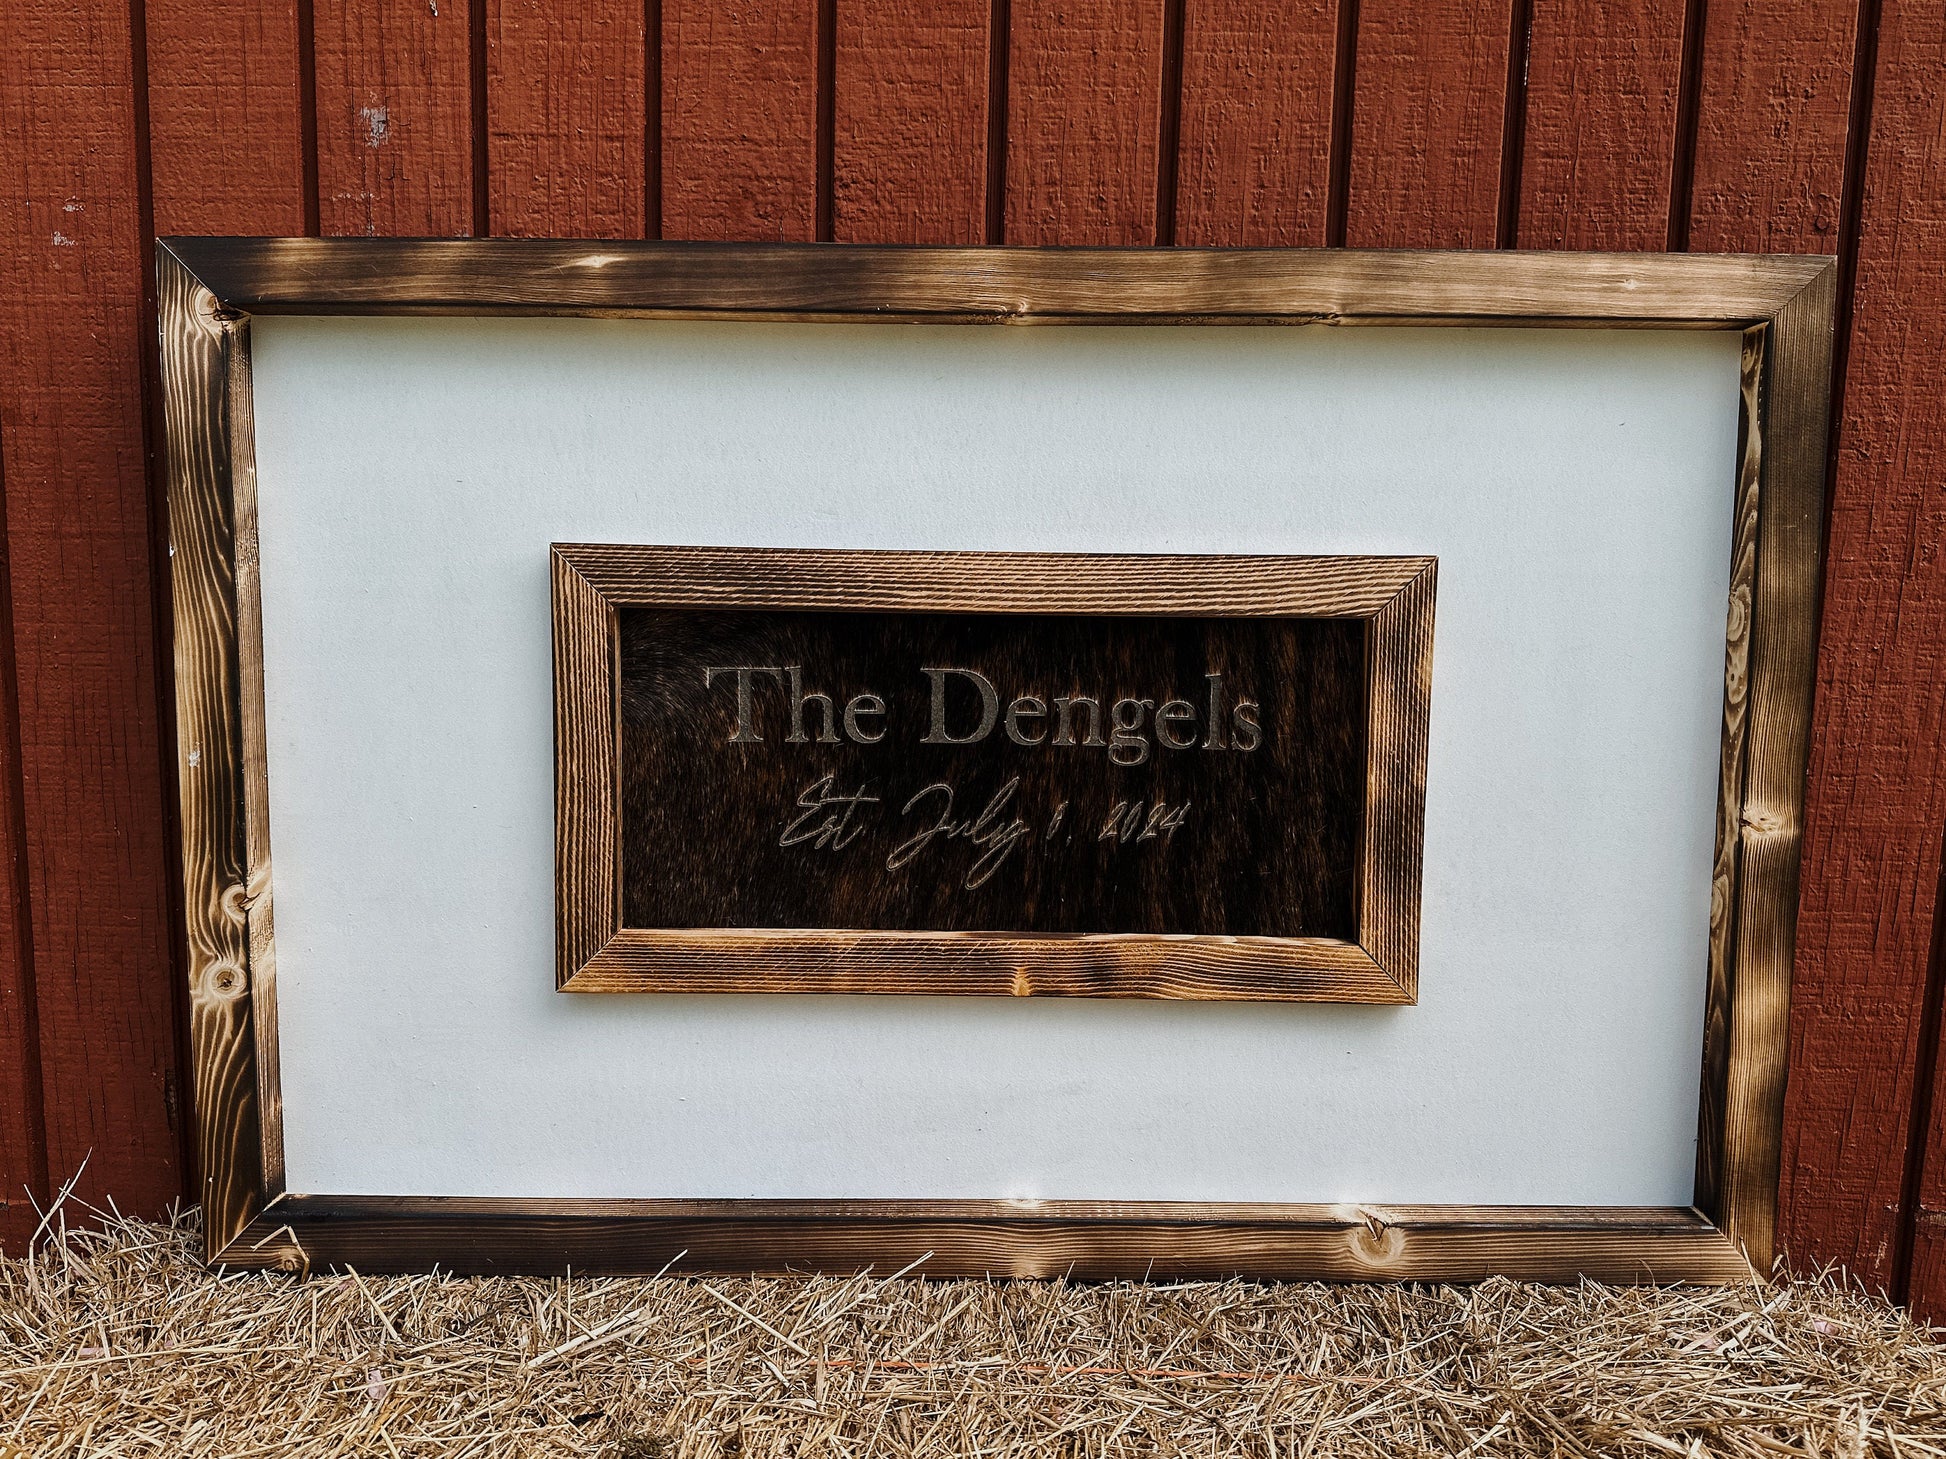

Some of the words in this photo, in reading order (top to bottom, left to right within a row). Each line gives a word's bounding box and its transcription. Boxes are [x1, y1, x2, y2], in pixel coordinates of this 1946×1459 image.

[705, 665, 888, 745] The
[919, 666, 1263, 767] Dengels
[779, 776, 880, 851] Est
[886, 777, 1030, 890] July
[1098, 799, 1192, 845] 2024
